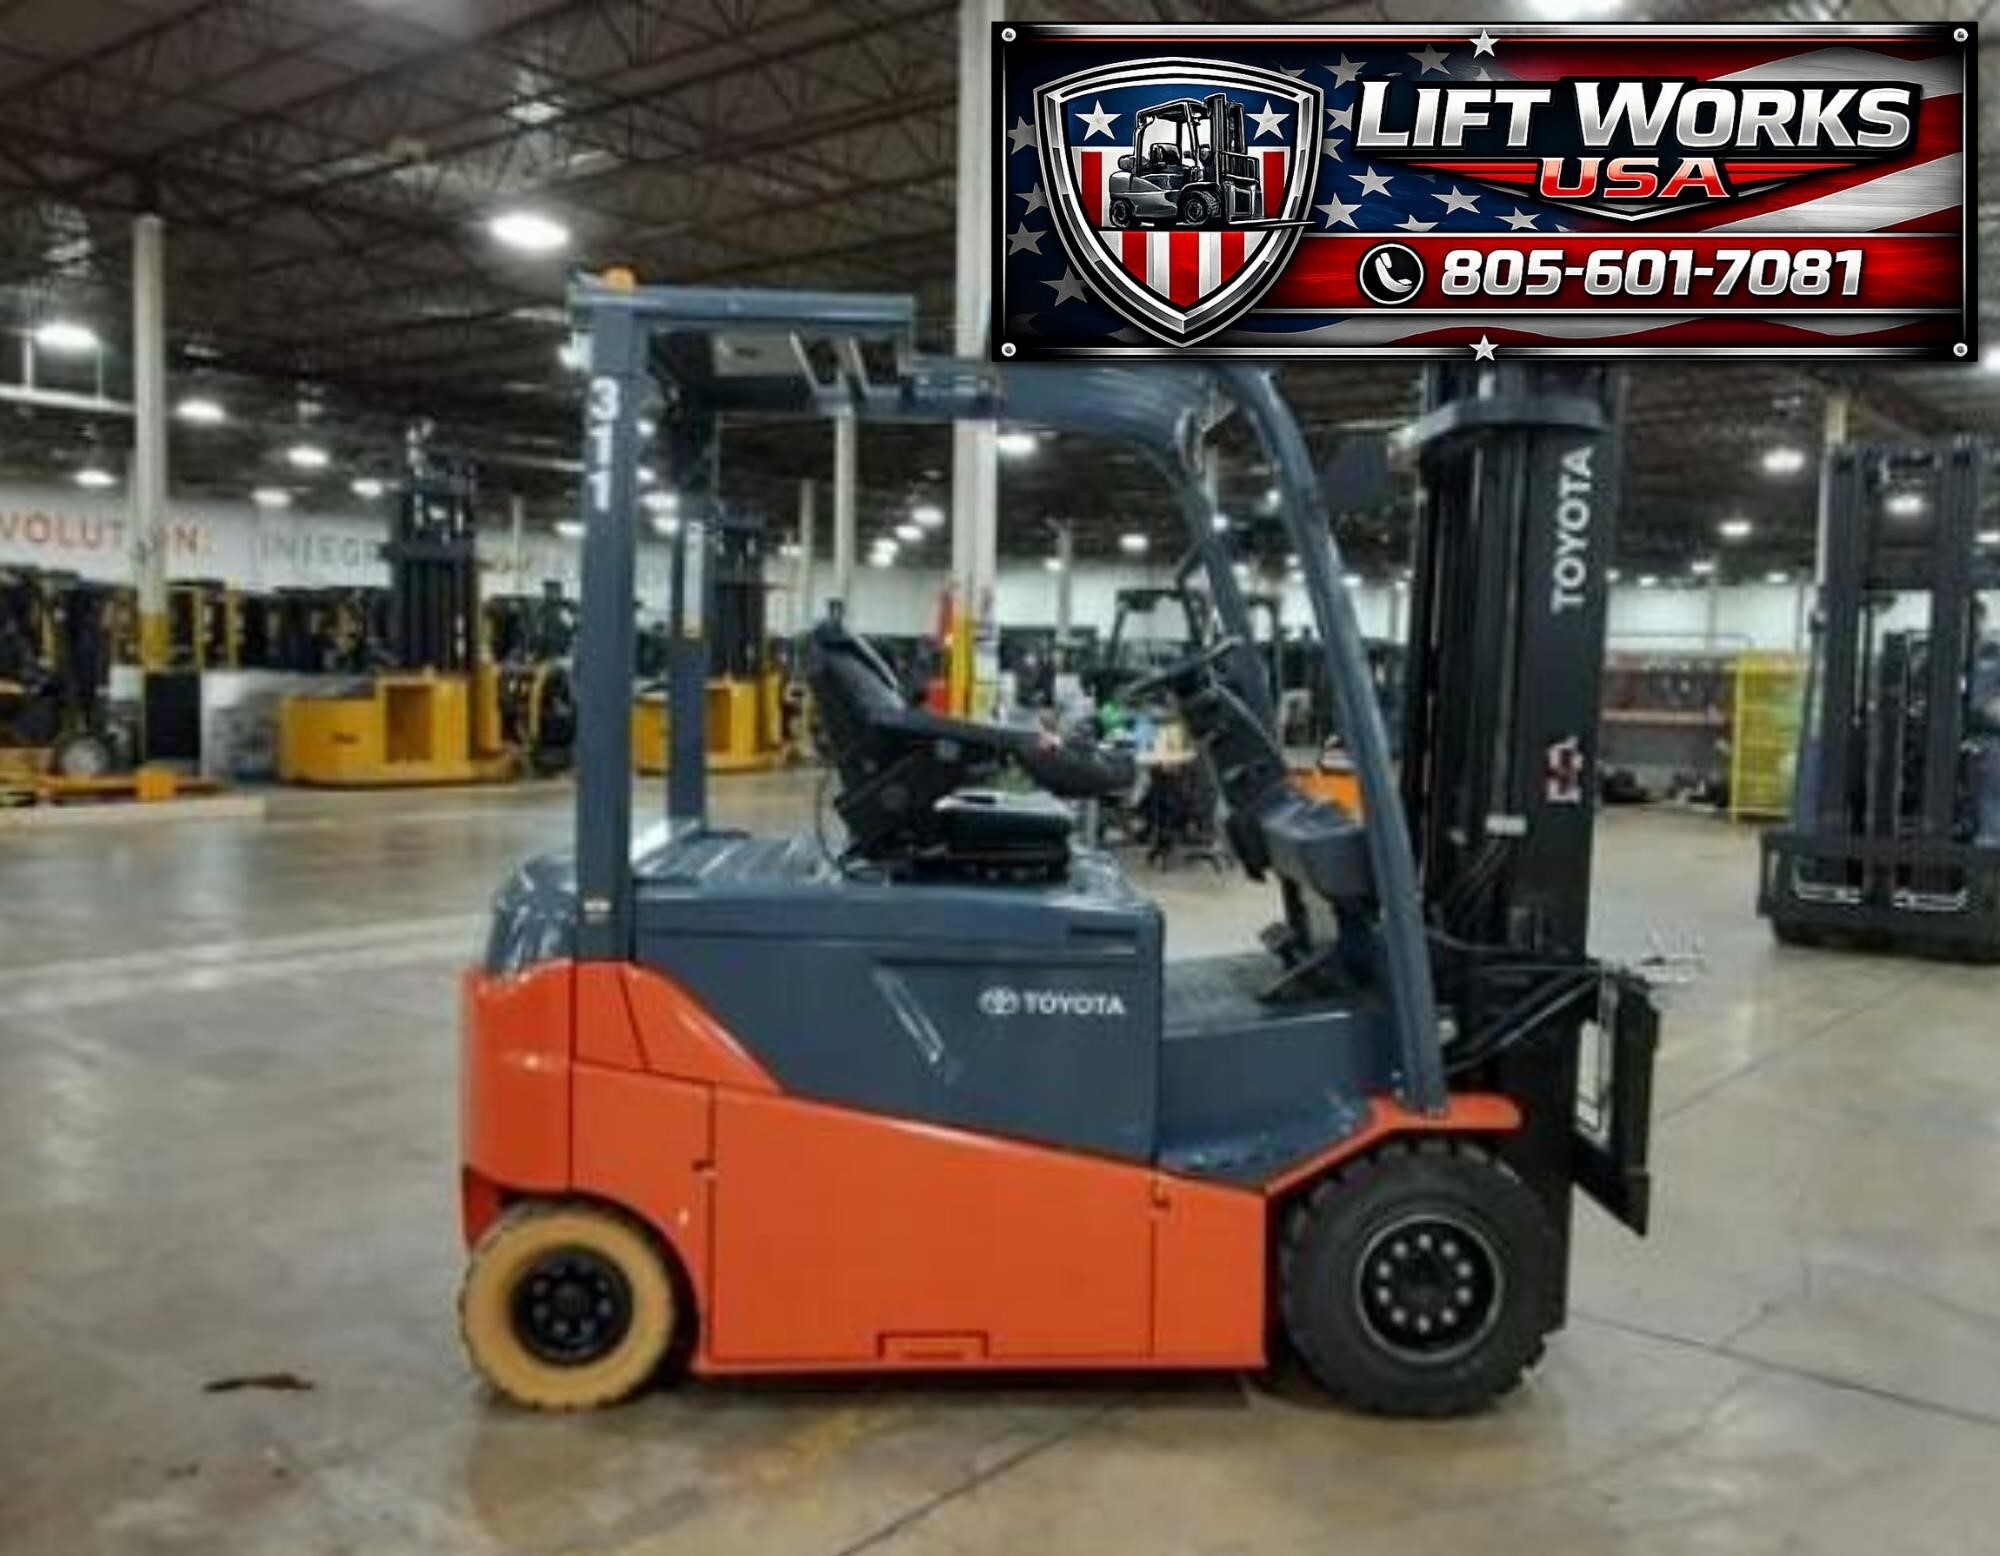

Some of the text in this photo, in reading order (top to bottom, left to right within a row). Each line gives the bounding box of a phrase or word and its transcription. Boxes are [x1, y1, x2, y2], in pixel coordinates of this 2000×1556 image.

[589, 376, 620, 512] 311
[1551, 446, 1593, 613] TOYOTA
[1023, 989, 1126, 1015] TOYOTA
